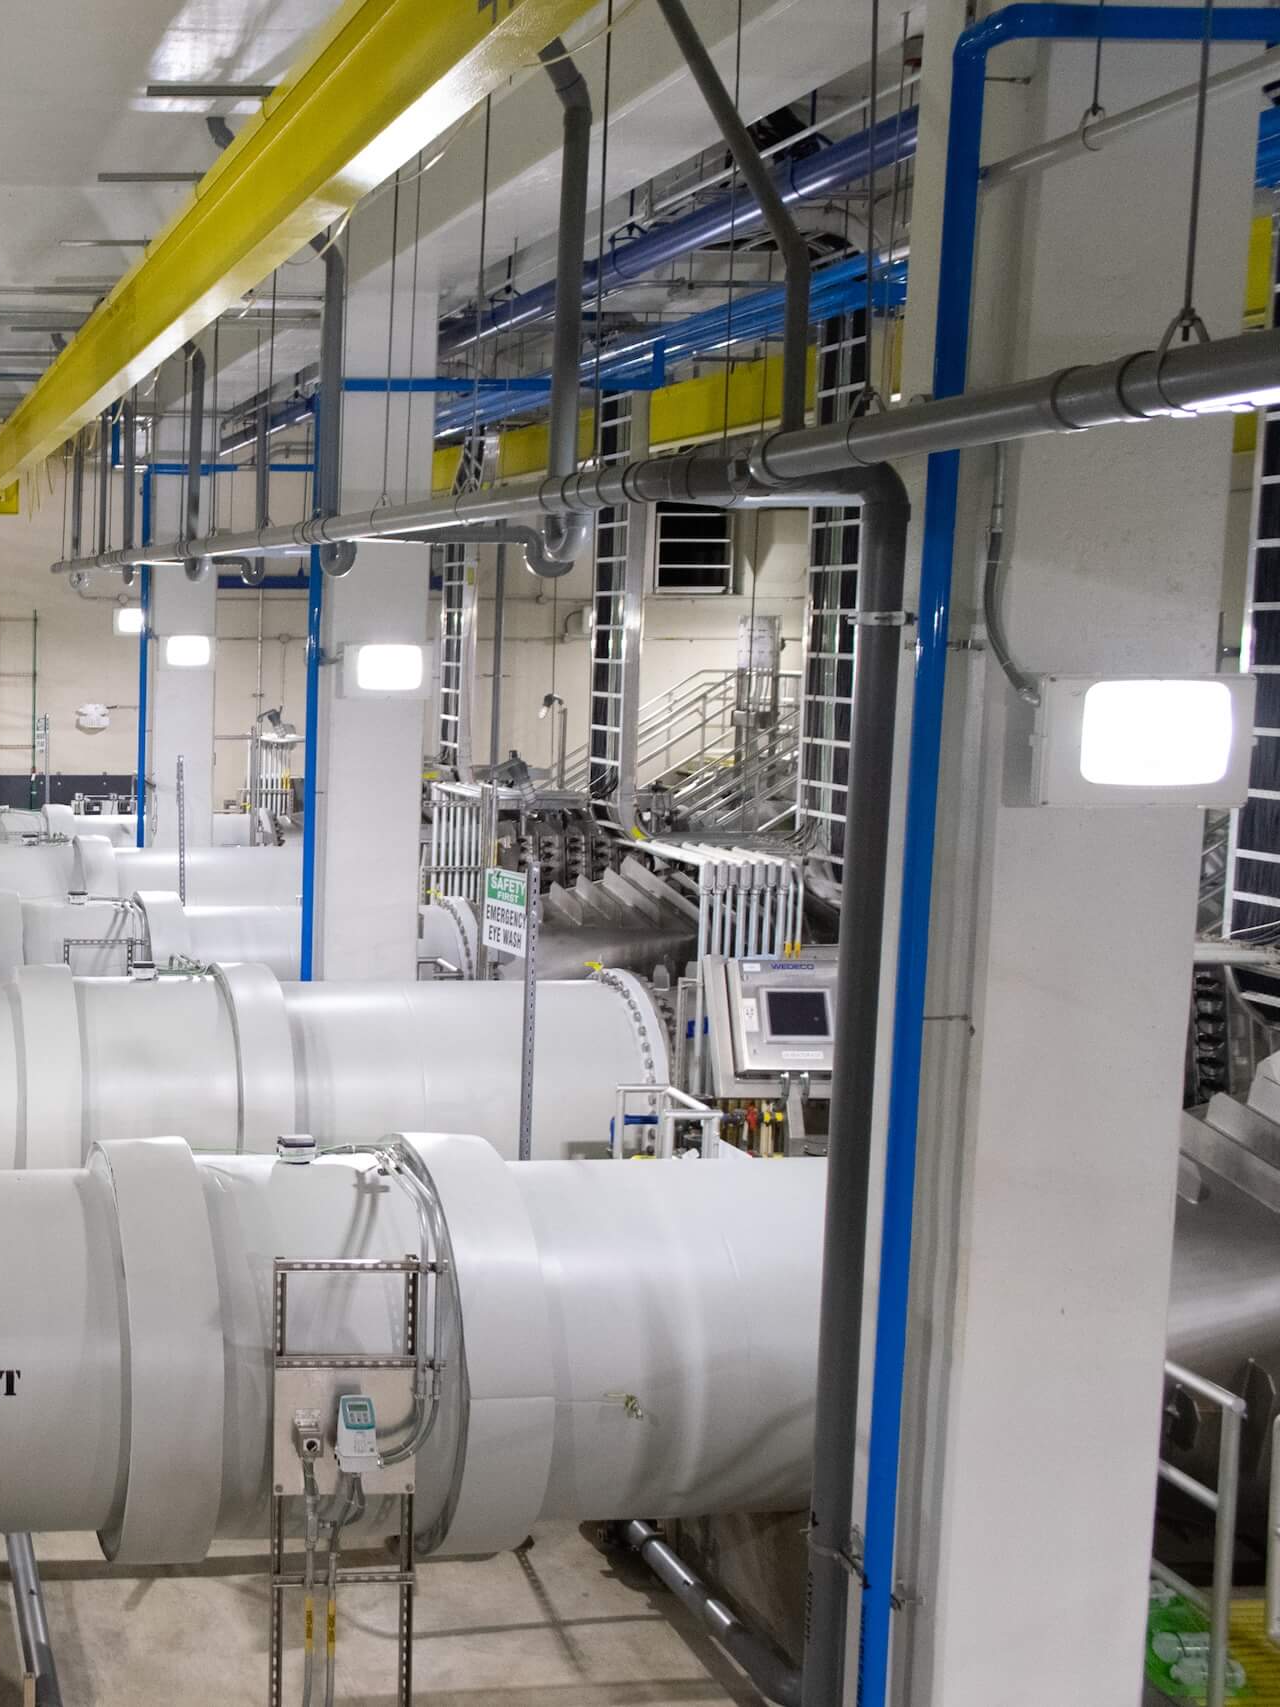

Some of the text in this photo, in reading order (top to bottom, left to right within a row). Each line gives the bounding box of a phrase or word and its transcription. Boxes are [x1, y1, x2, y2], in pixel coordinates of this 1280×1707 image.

[490, 875, 526, 897] SAFETY
[497, 890, 519, 904] FIRST
[486, 903, 528, 929] EMERGENCY
[488, 924, 522, 949] EYE WASH
